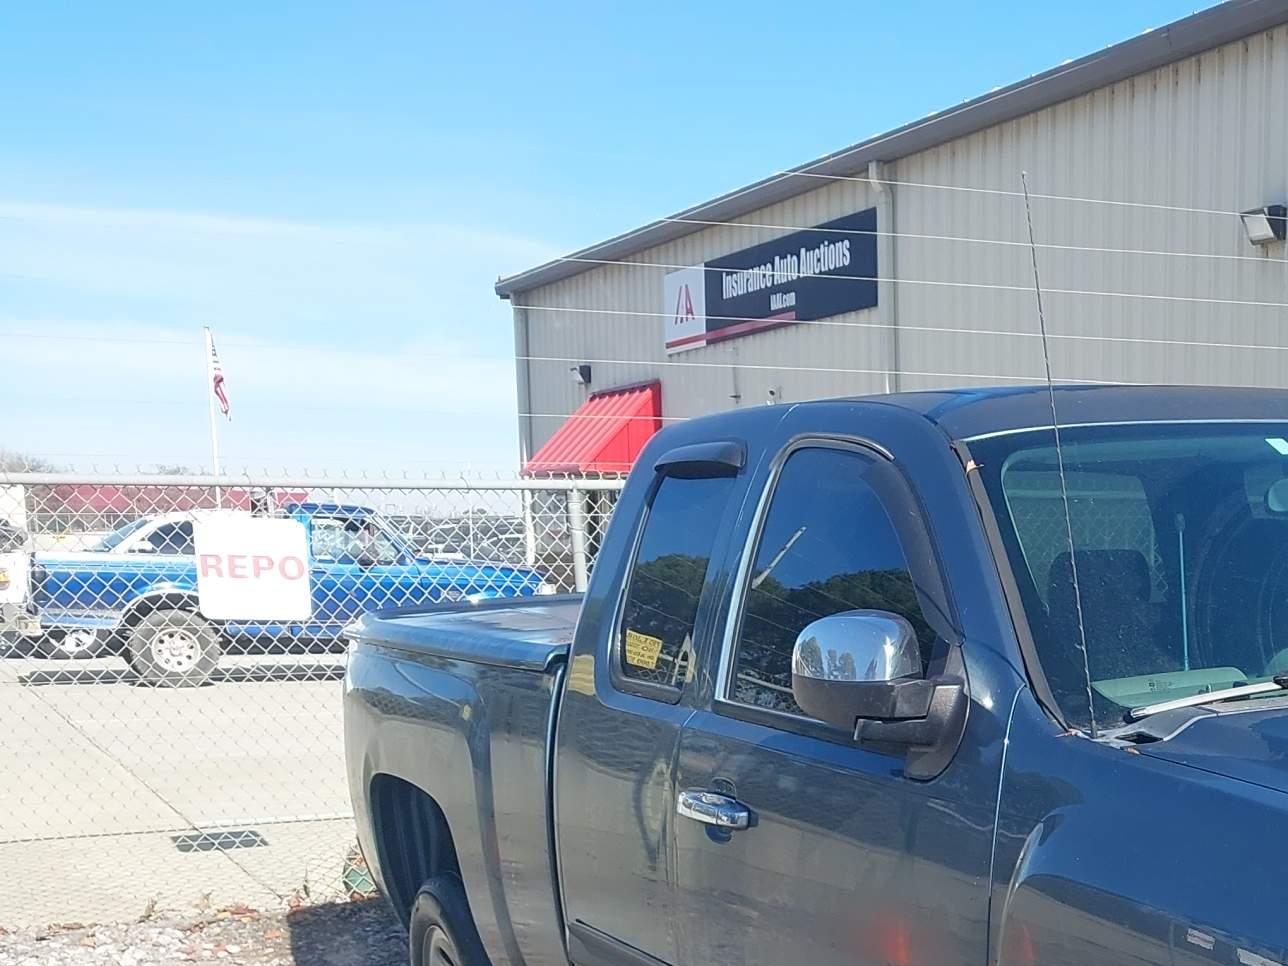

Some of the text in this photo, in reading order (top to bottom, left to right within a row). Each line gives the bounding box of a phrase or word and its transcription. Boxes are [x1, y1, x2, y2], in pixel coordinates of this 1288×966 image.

[722, 239, 850, 300] Insurance Auto Auctions
[200, 554, 305, 580] REPO
